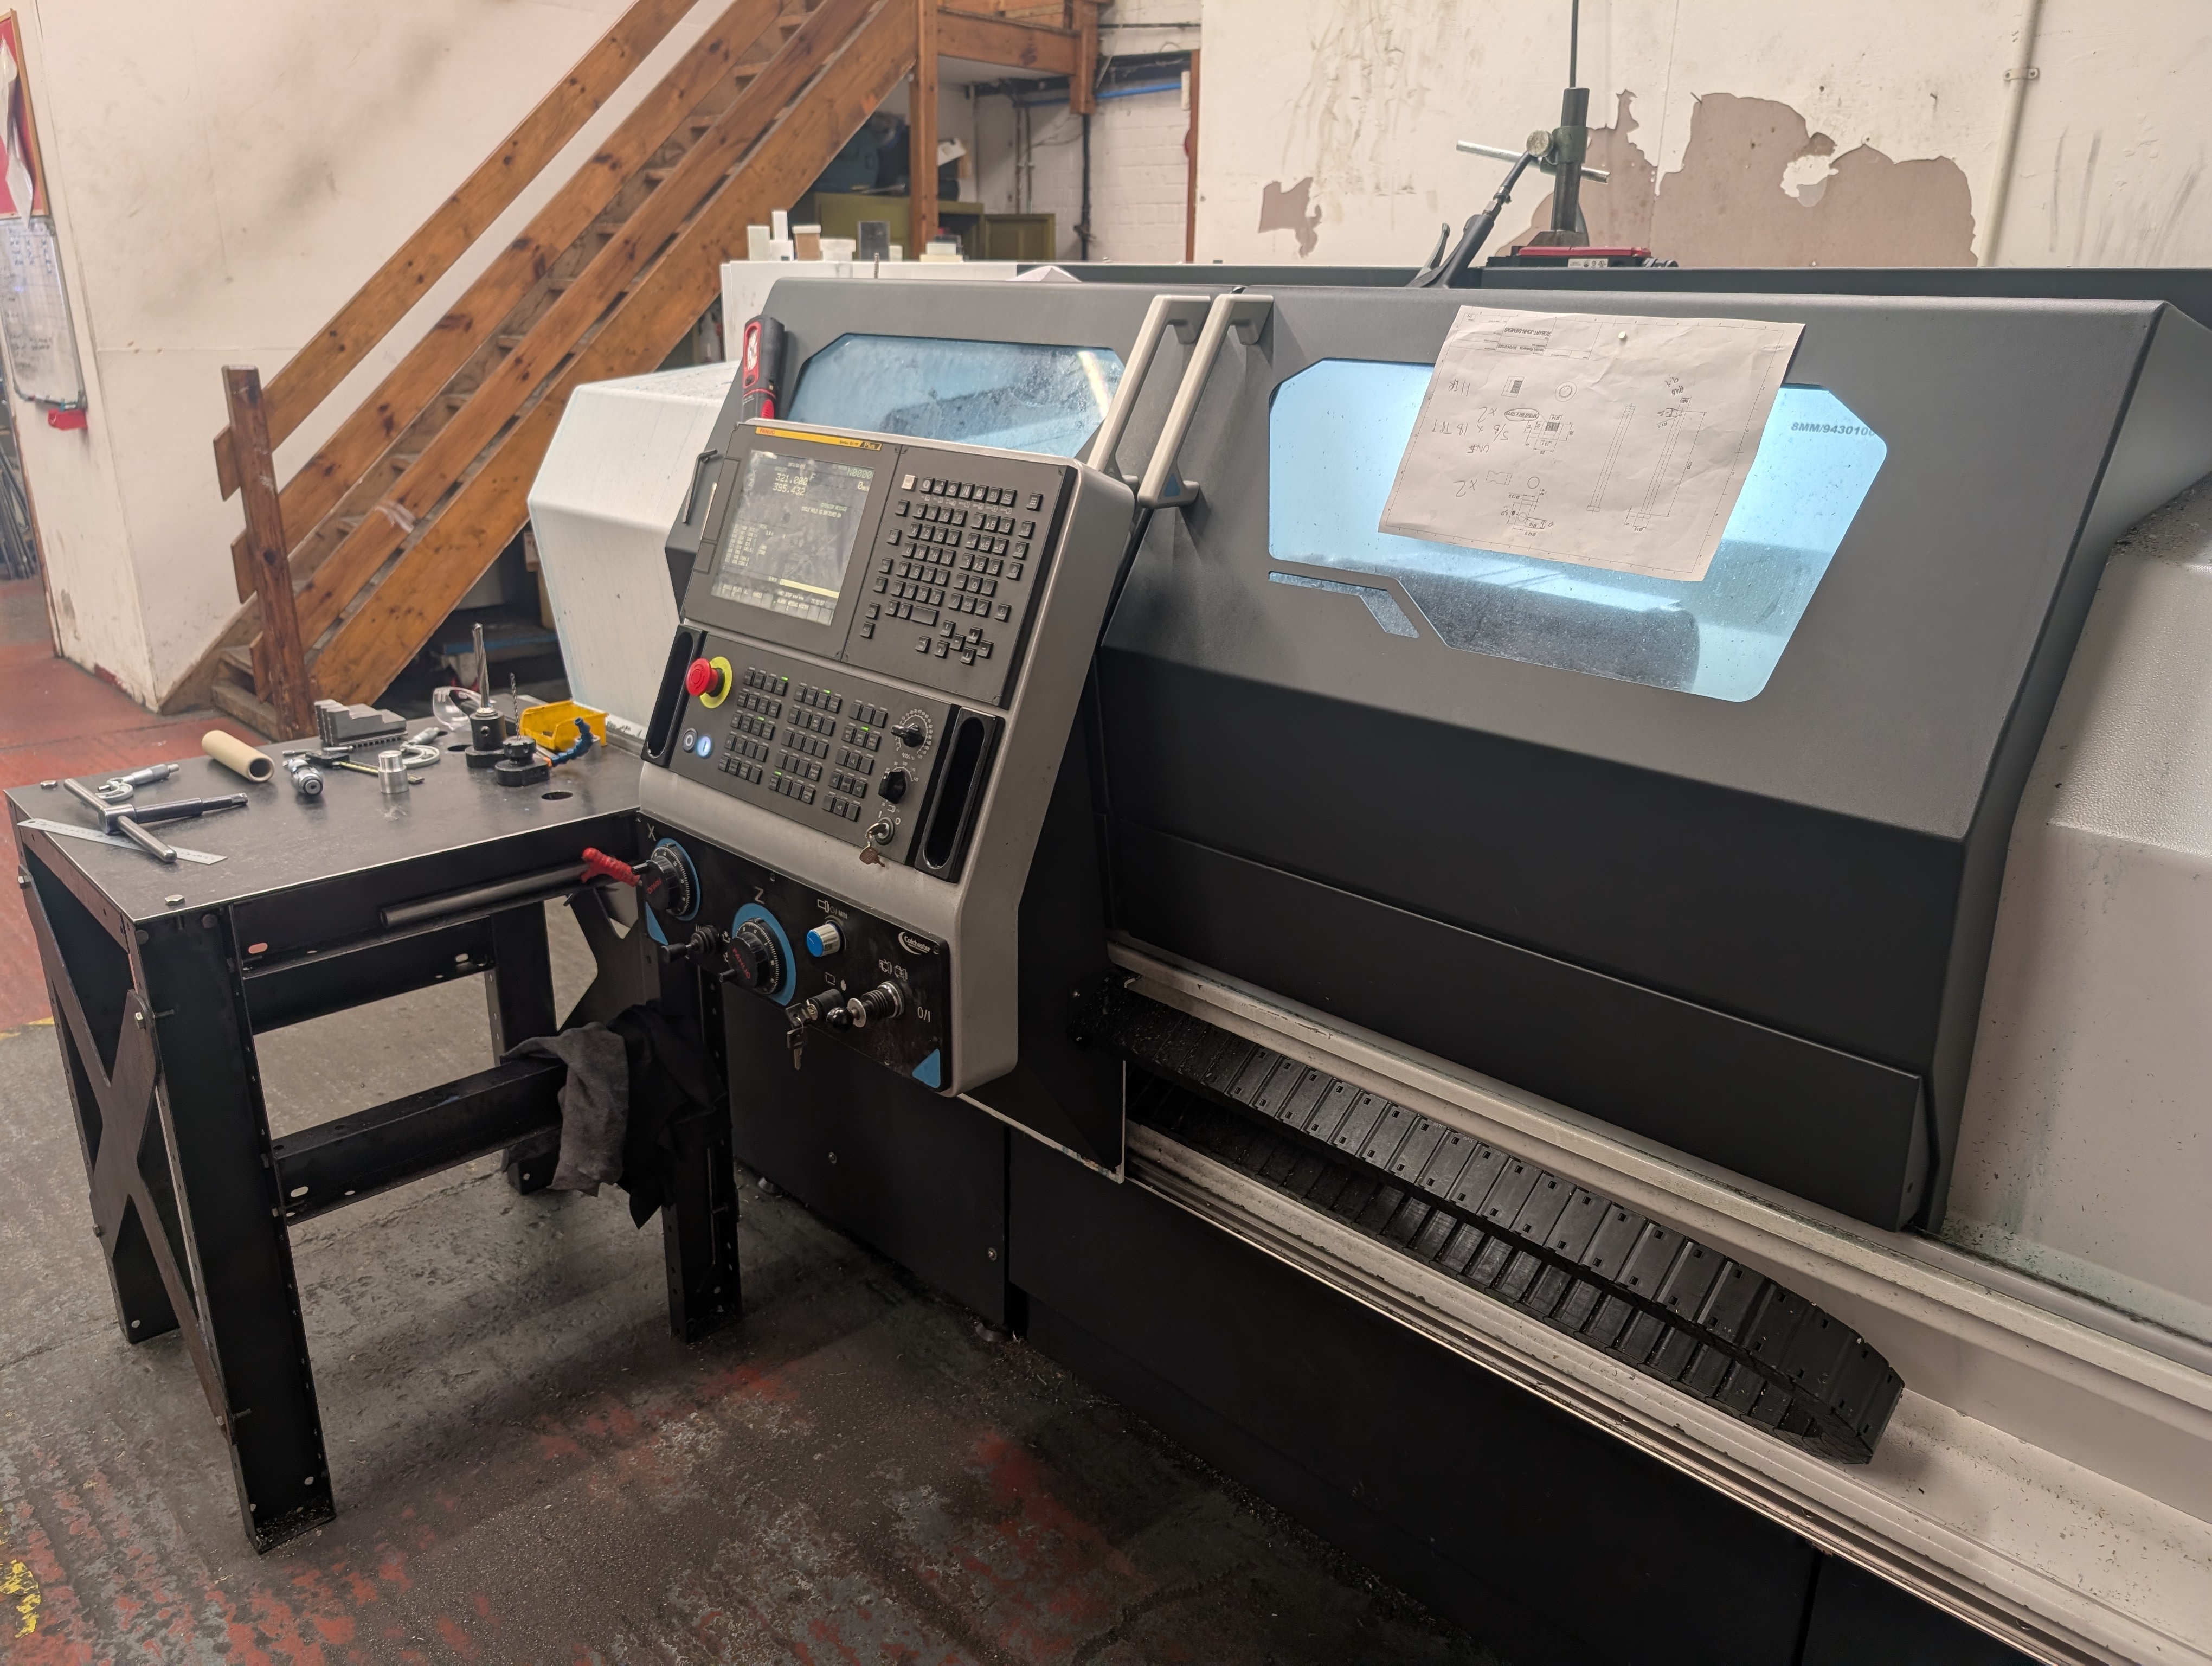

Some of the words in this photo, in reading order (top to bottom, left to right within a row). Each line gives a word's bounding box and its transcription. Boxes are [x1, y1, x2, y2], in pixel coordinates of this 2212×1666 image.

[1457, 422, 1469, 436] 18
[864, 441, 876, 449] Plus
[775, 473, 809, 486] 321.000
[773, 482, 806, 496] 395.432
[647, 823, 657, 842] X
[754, 886, 766, 905] Z
[904, 935, 931, 952] Colchester
